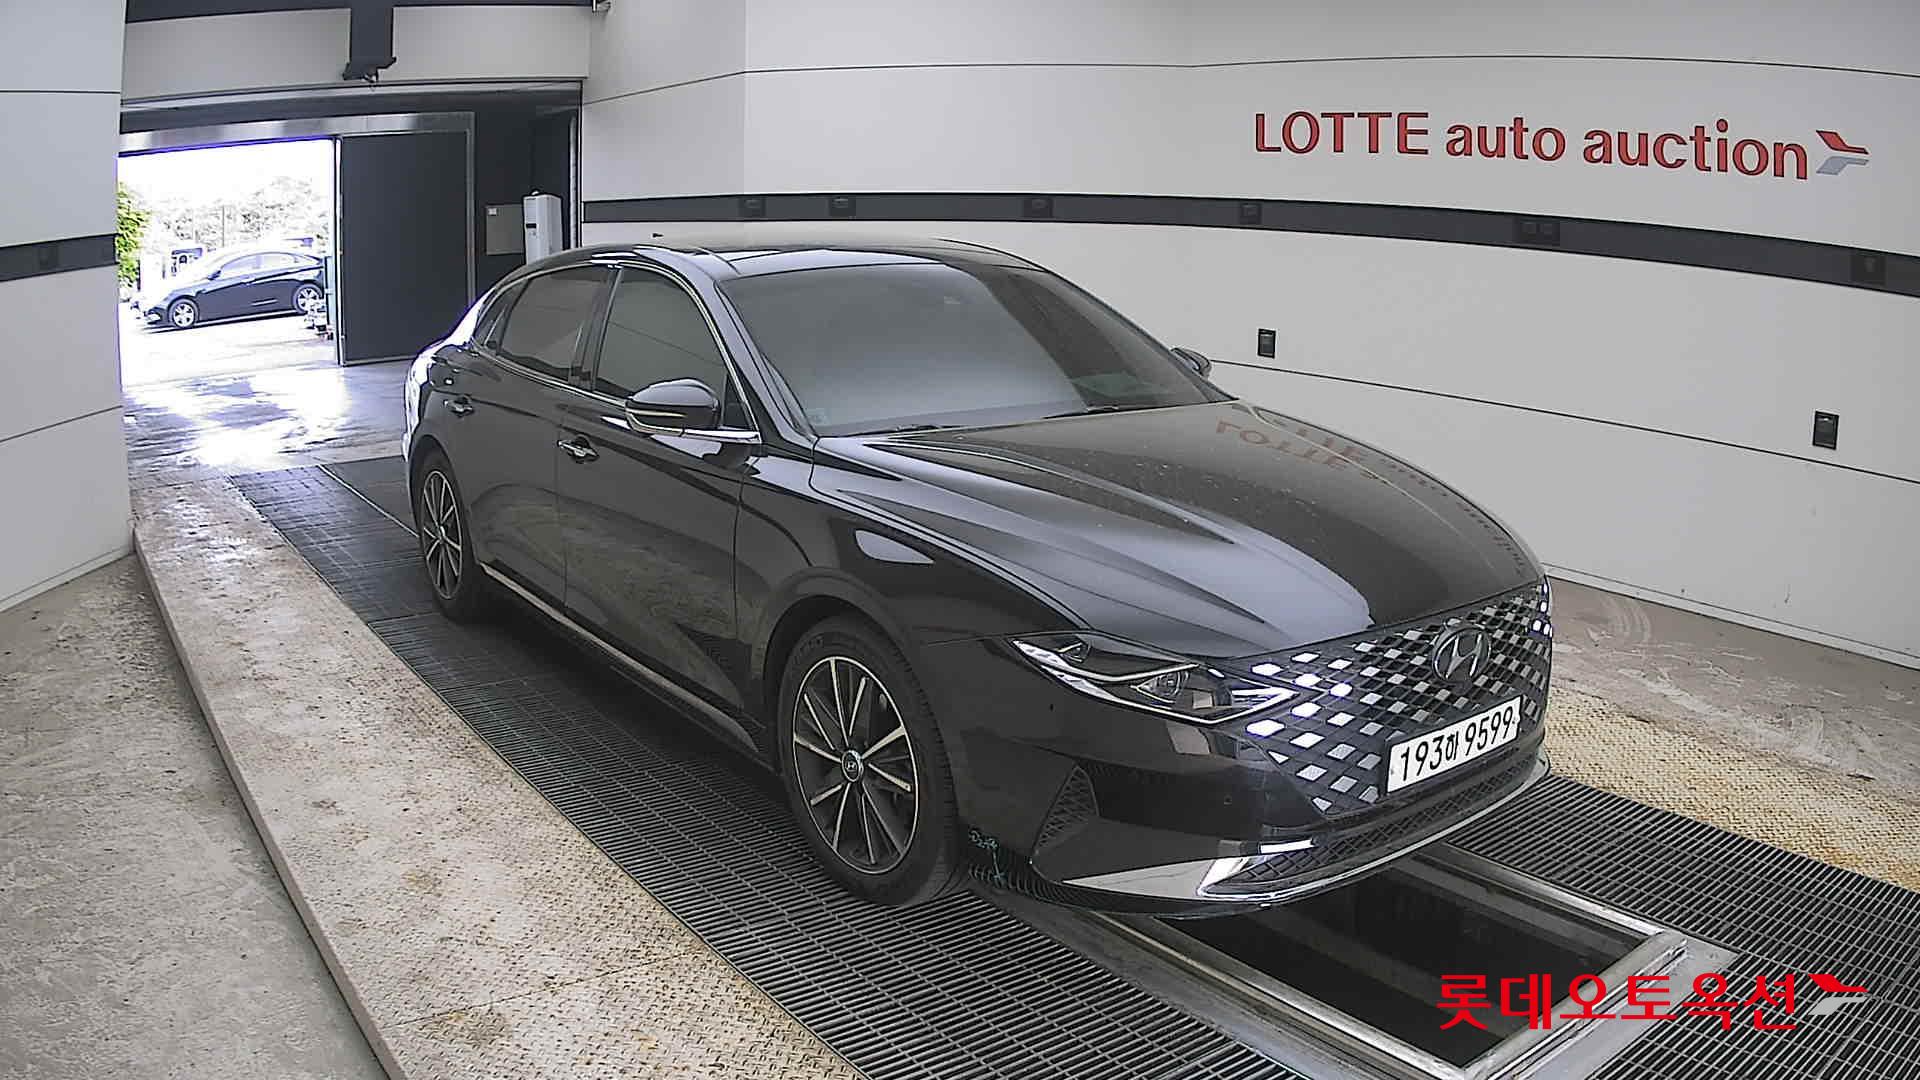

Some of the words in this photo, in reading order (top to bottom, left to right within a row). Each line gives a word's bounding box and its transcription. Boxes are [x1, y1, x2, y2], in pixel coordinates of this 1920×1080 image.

[1255, 111, 1429, 155] LOTTE
[1446, 116, 1566, 162] auto
[1582, 118, 1809, 180] auction
[1464, 705, 1514, 757] 9599
